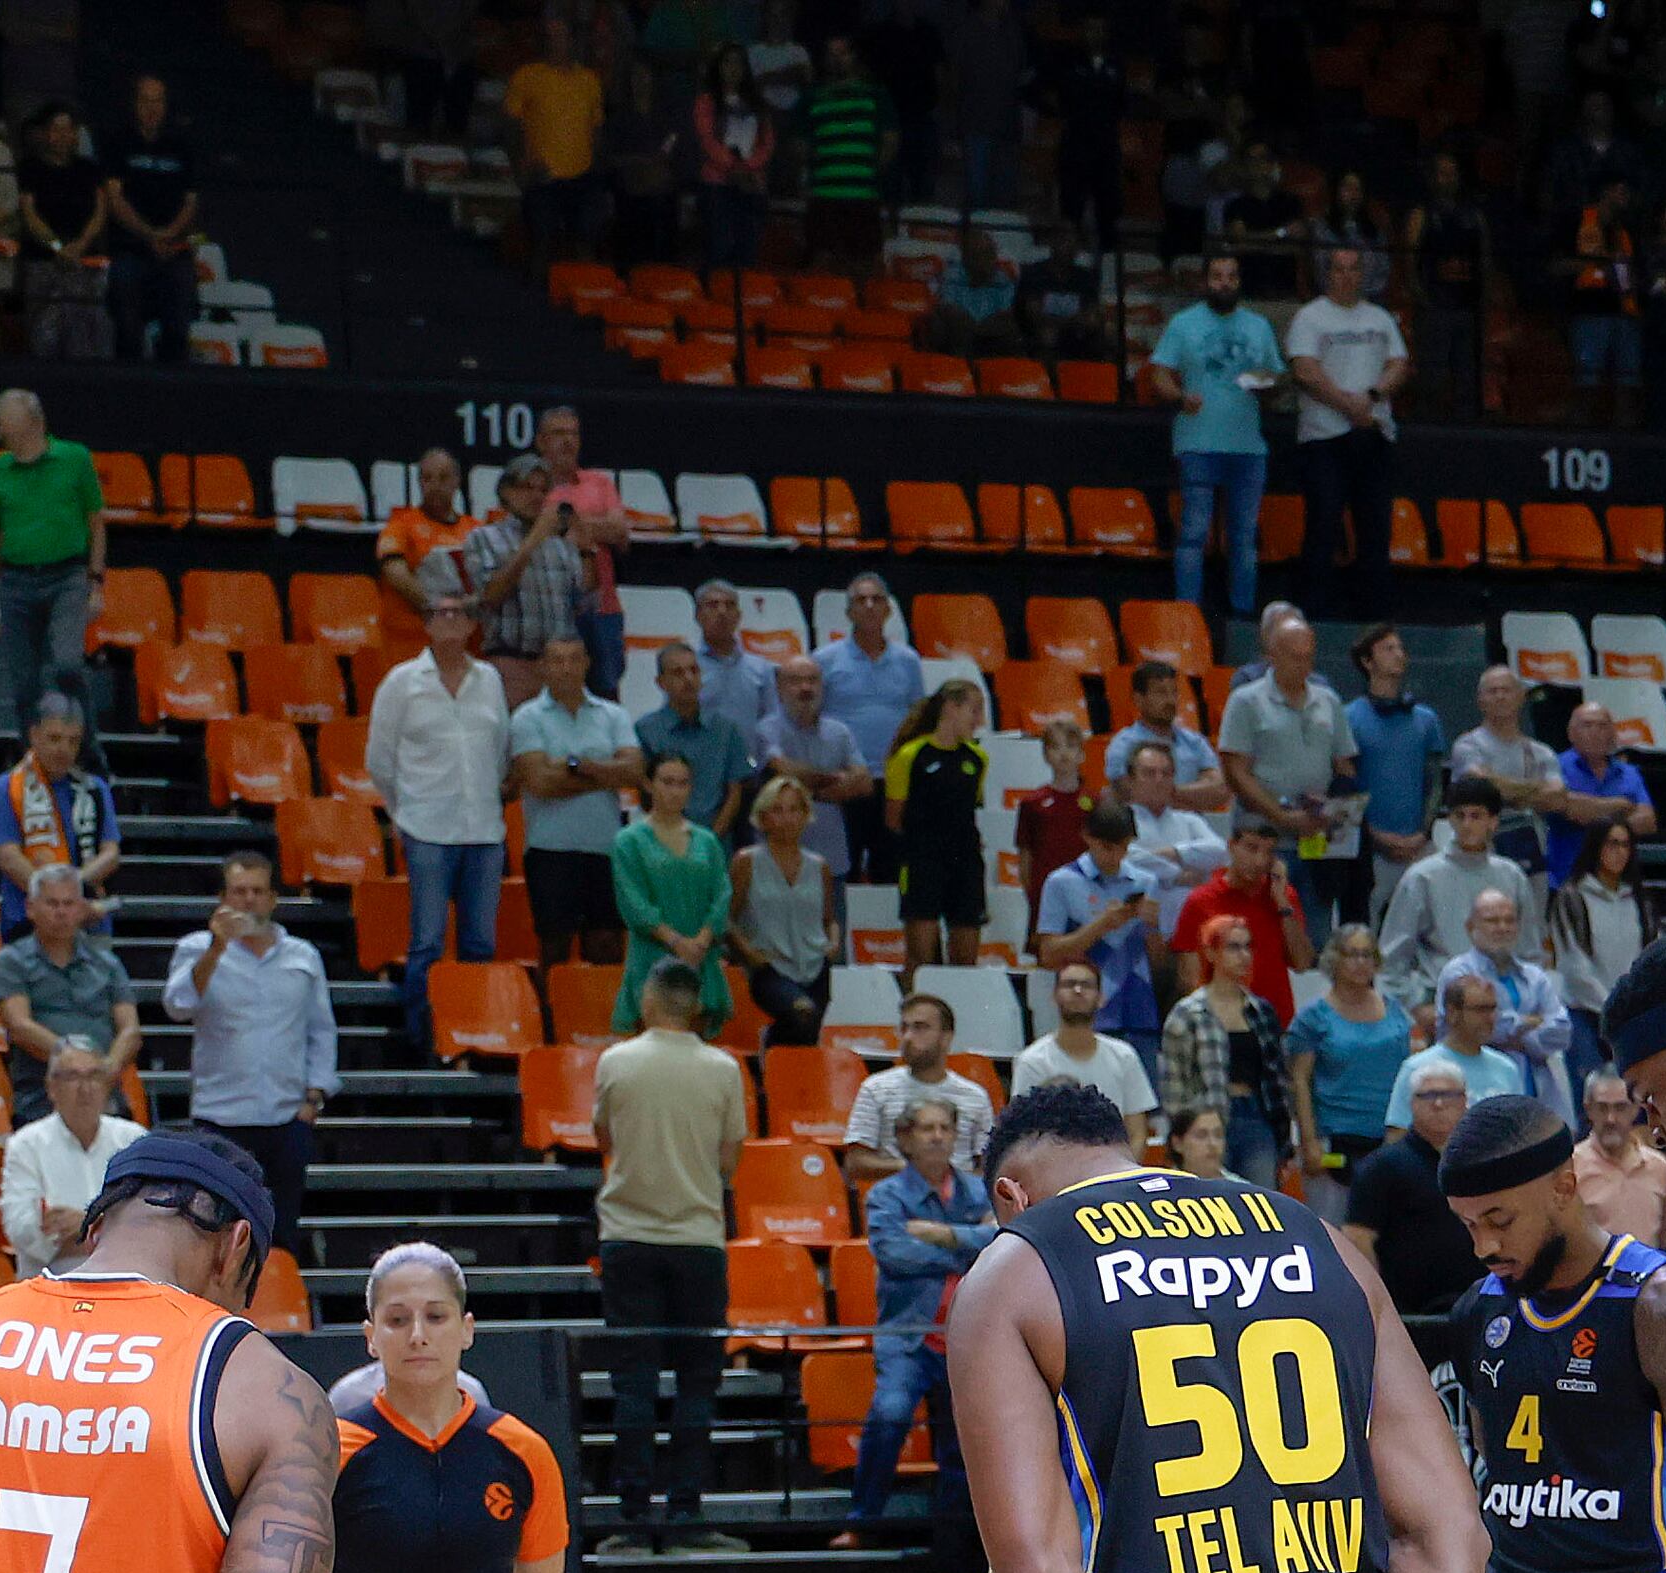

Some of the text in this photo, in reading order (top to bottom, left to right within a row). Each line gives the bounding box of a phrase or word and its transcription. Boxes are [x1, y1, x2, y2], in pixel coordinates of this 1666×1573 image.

[457, 402, 533, 449] 110
[1542, 447, 1610, 493] 109
[1074, 1191, 1285, 1245] COLSON II
[1095, 1244, 1314, 1310] Rapyd
[1131, 1317, 1347, 1498] 50
[1505, 1394, 1544, 1464] 4
[1483, 1473, 1621, 1530] aytika
